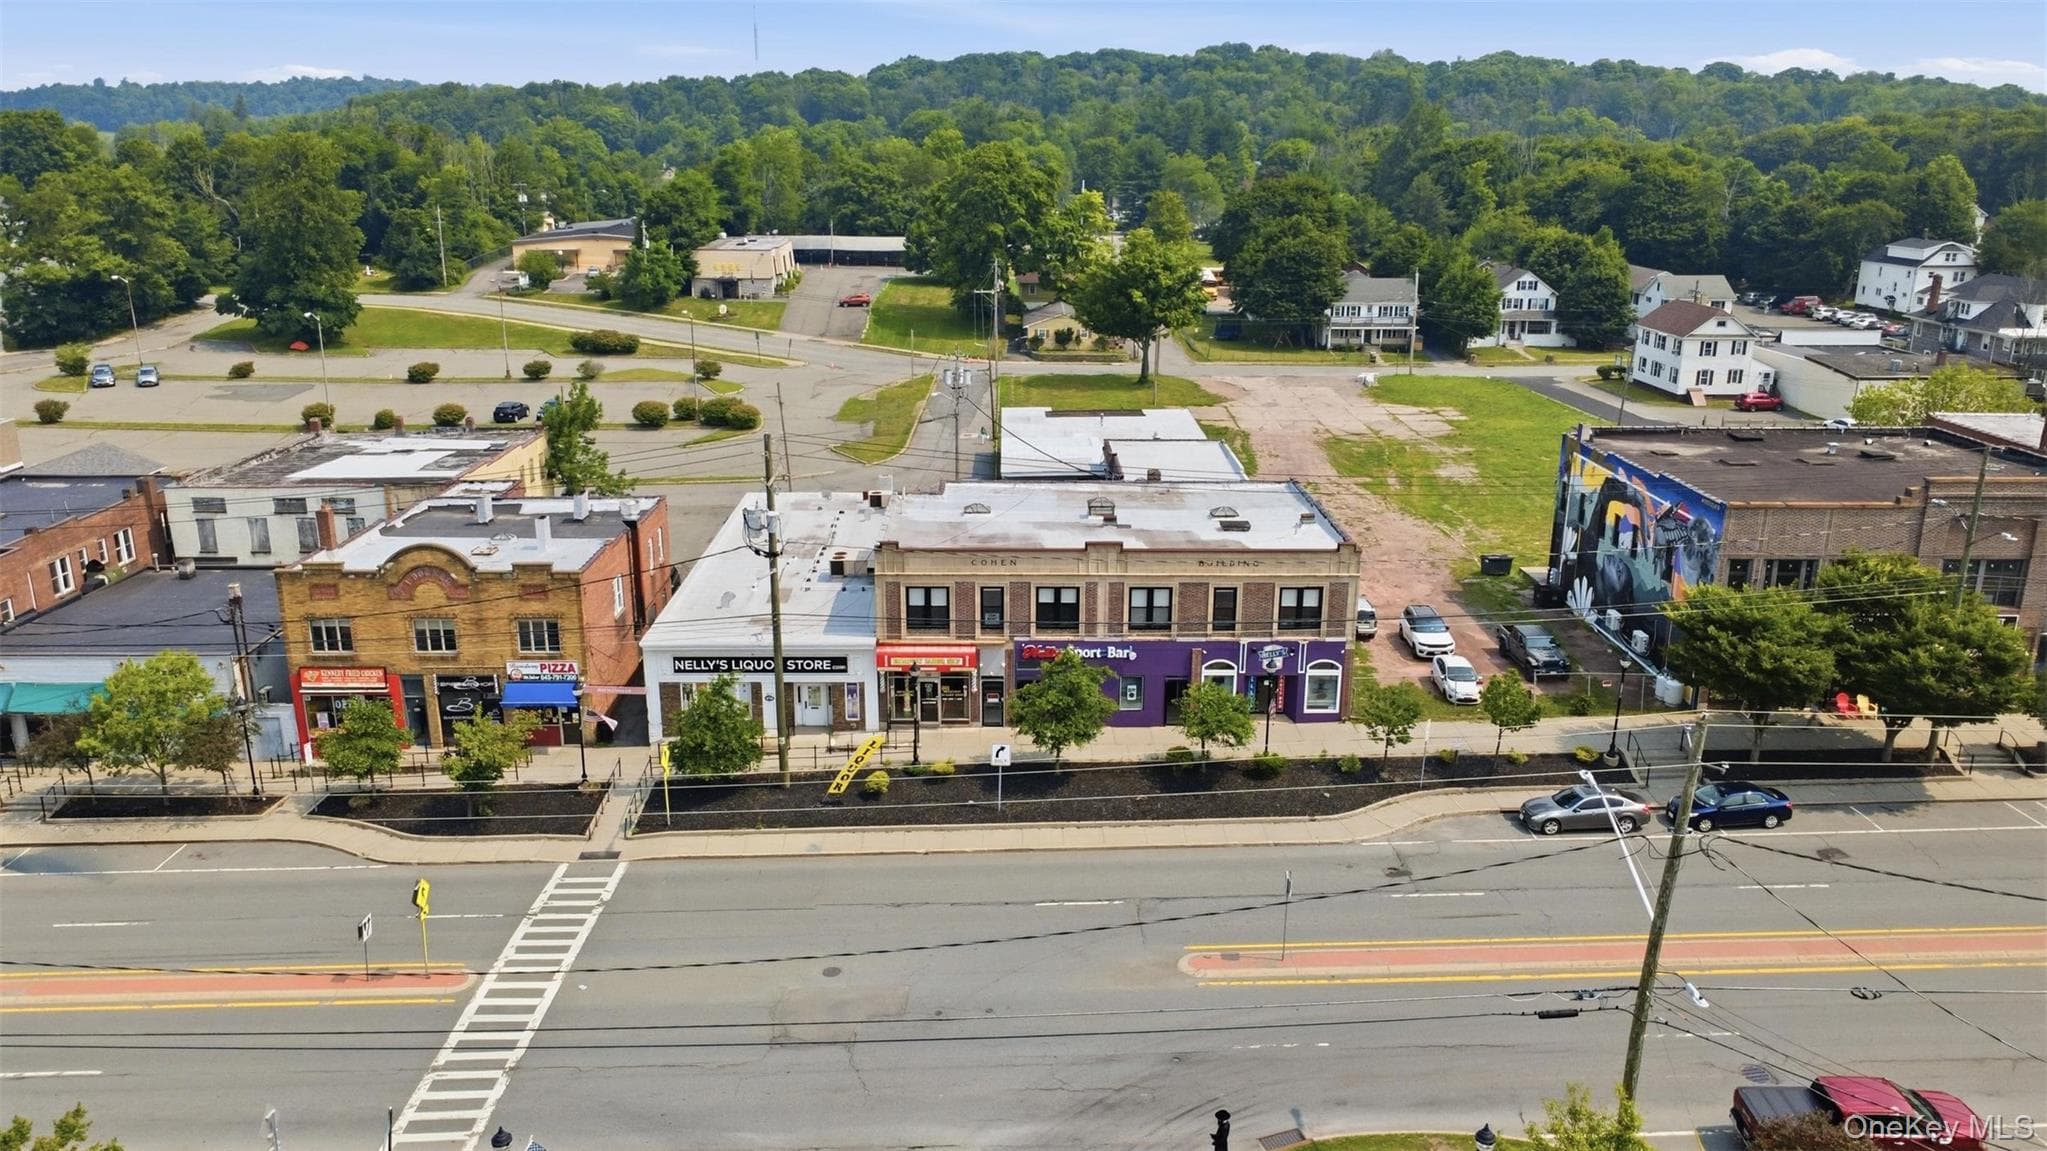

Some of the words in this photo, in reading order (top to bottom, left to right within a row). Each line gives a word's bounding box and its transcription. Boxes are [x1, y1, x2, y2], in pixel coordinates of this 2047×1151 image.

[540, 663, 576, 673] PIZZA
[674, 659, 729, 670] NELLY'S
[731, 659, 777, 671] LIQUO
[786, 659, 832, 670] STORE
